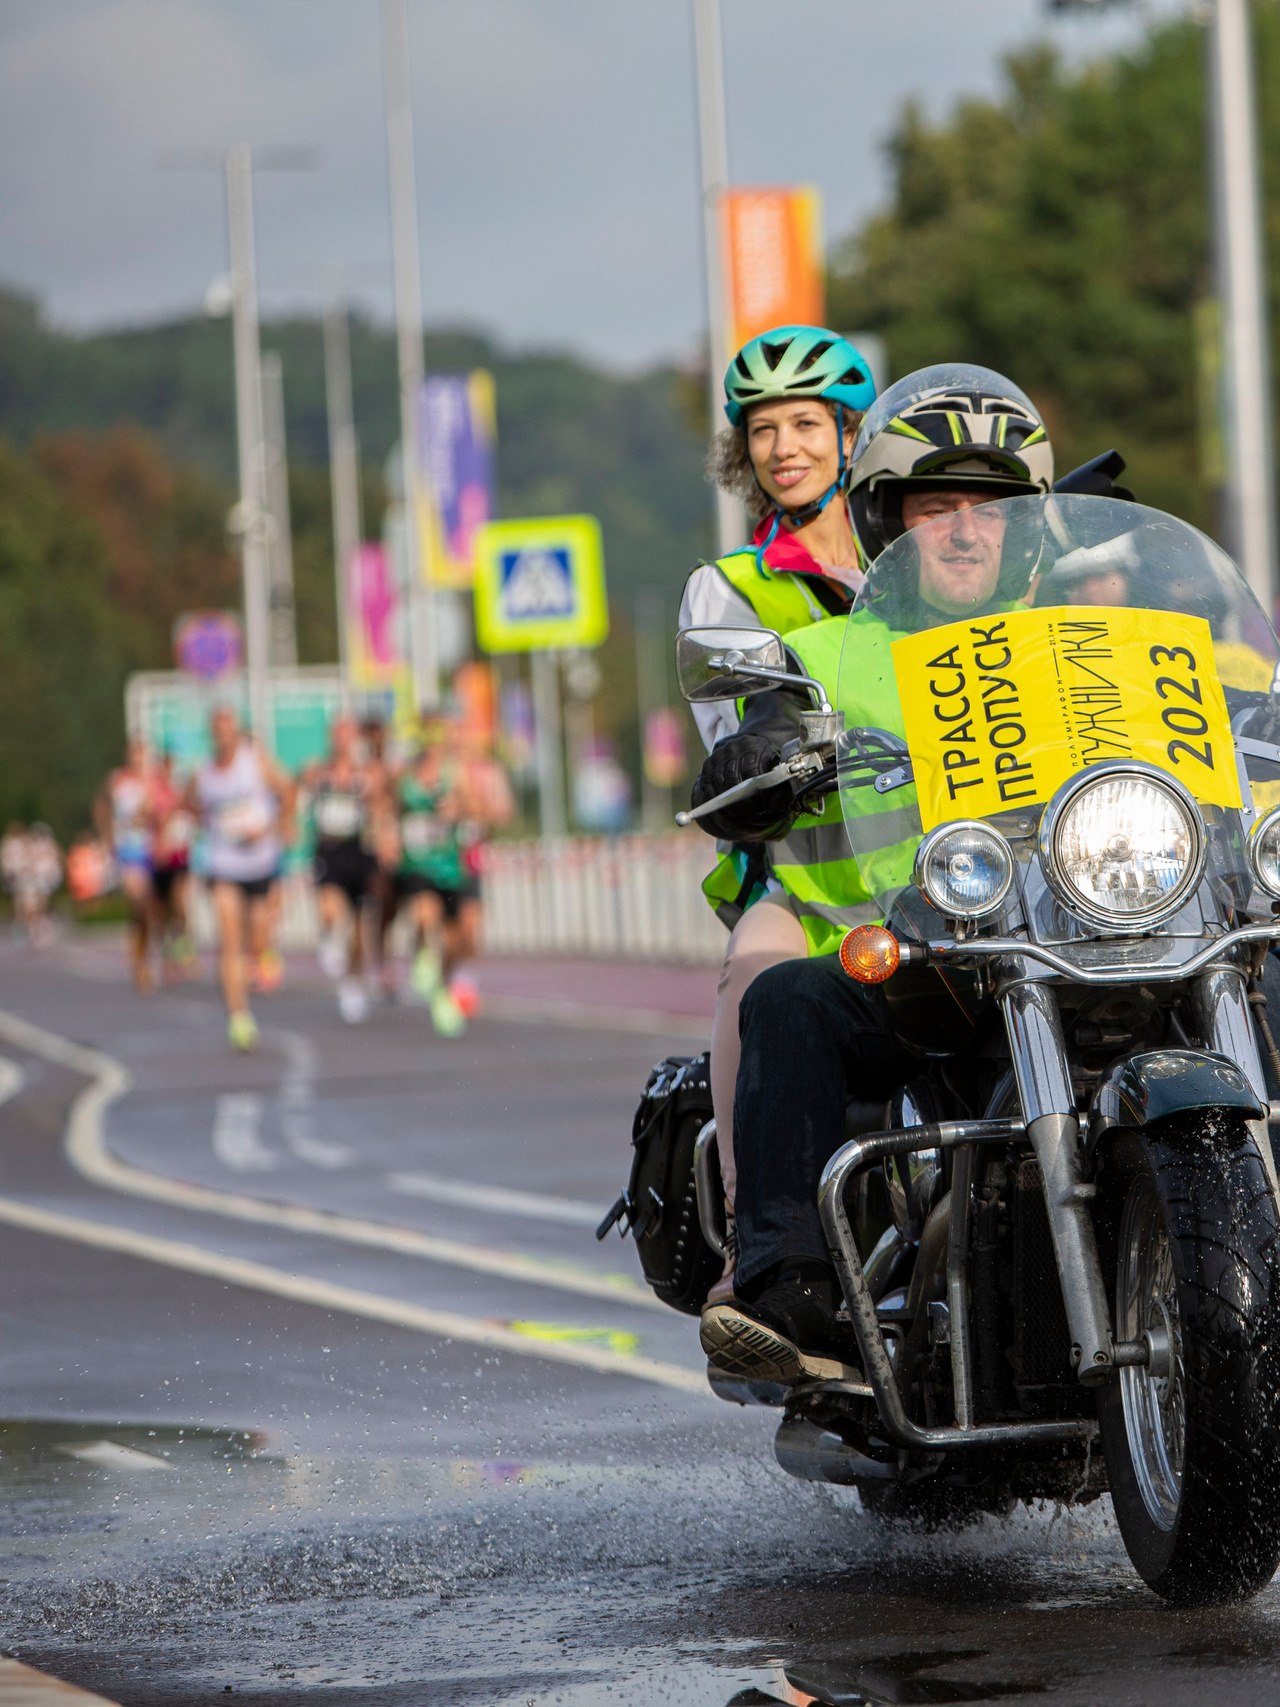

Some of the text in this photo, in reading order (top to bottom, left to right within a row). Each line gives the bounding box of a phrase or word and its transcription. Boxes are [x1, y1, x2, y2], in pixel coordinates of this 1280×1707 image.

[926, 644, 985, 801] ТРАССА
[969, 620, 1037, 802] ПРОПУСК
[1056, 679, 1079, 767] ПОЛУМАРАФОН
[1149, 644, 1215, 771] 2023
